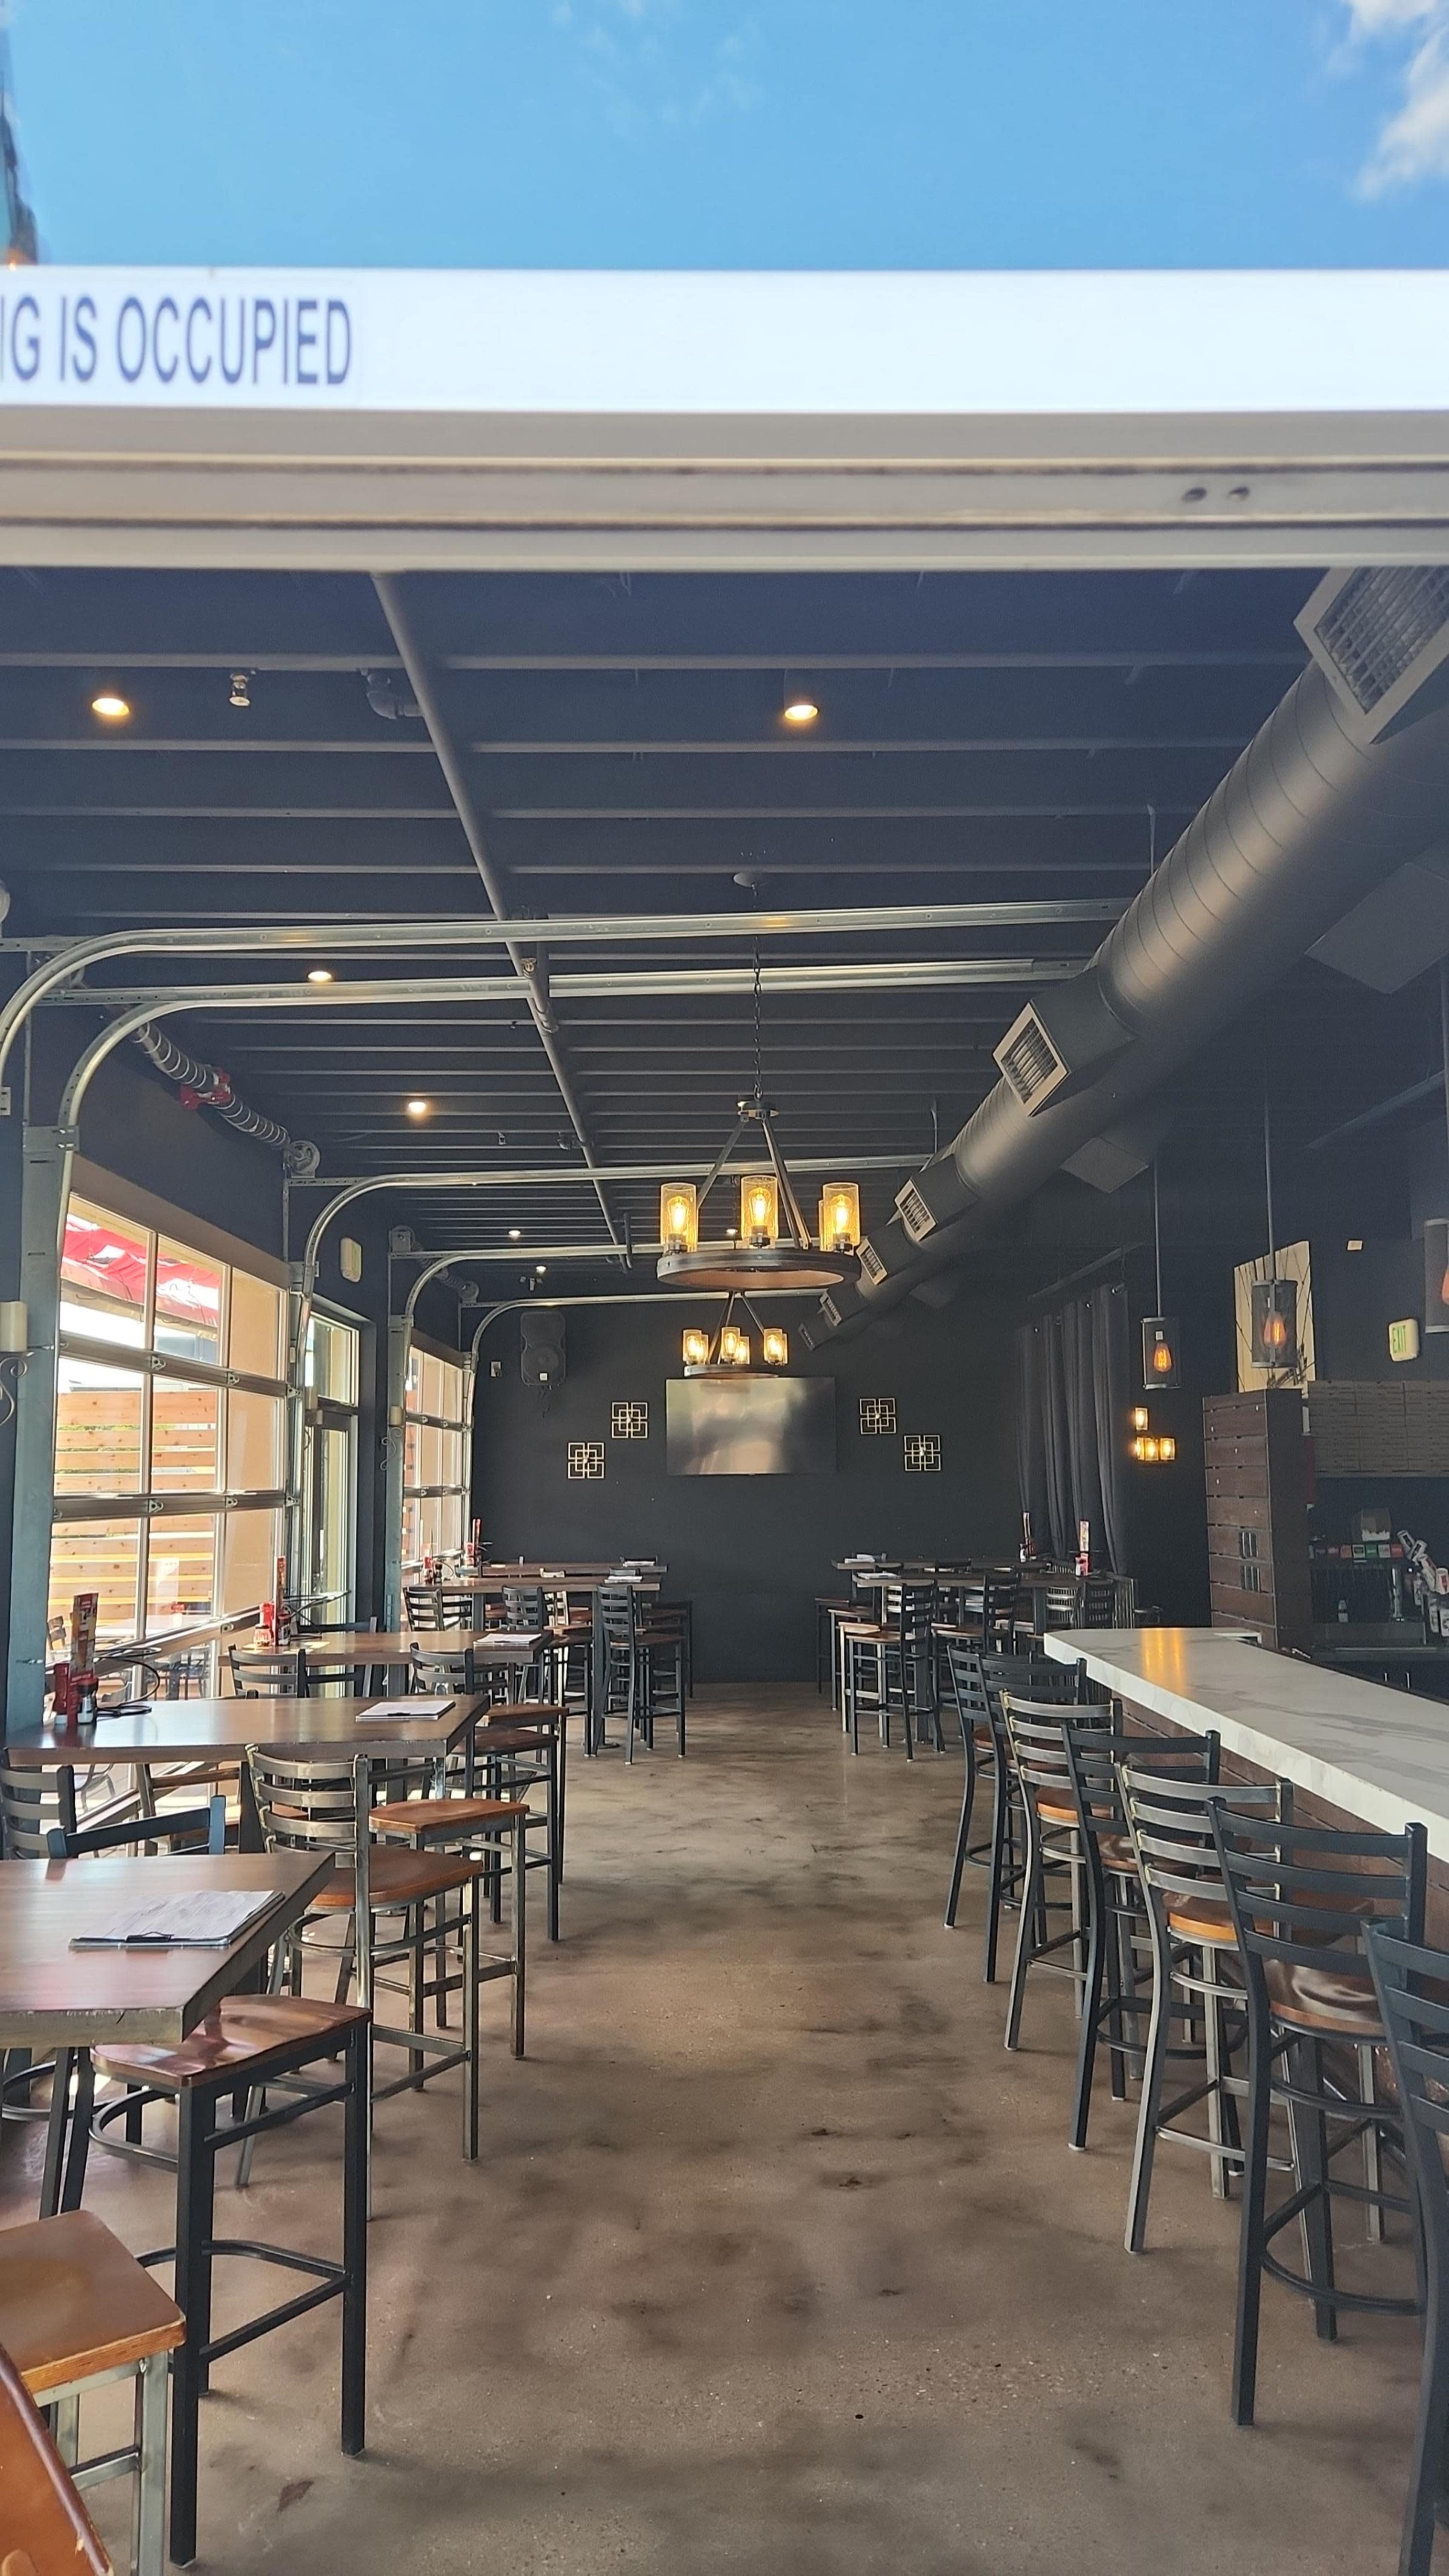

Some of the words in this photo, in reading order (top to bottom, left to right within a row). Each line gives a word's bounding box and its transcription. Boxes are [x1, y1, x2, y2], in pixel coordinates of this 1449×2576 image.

[0, 295, 40, 383] G
[60, 295, 97, 384] IS
[117, 295, 351, 385] OCCUPIED
[1392, 1325, 1406, 1353] EXIT
